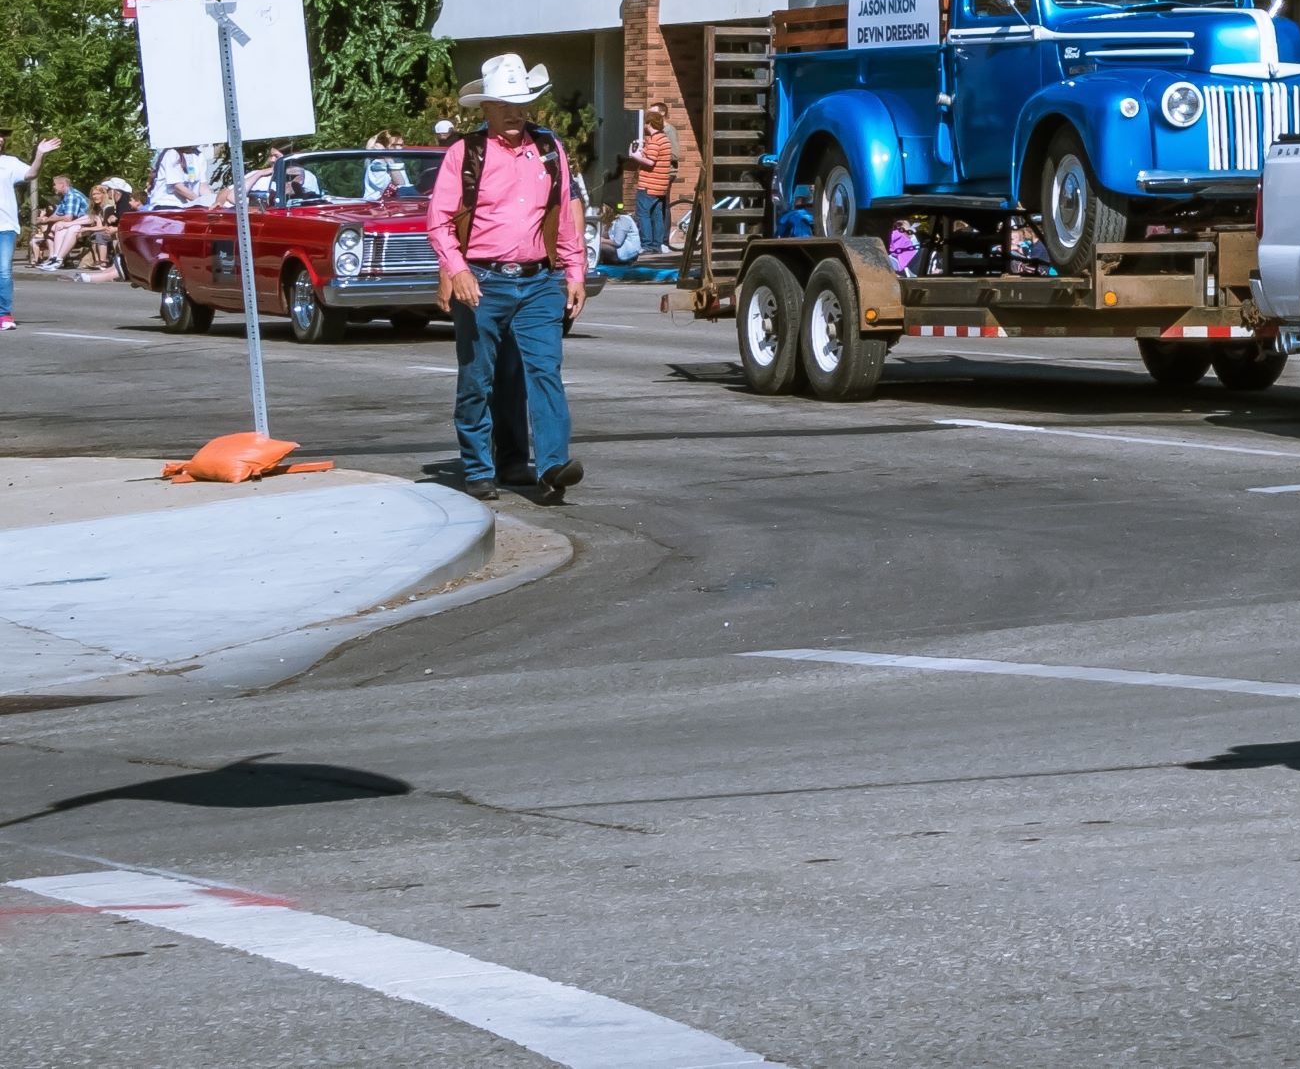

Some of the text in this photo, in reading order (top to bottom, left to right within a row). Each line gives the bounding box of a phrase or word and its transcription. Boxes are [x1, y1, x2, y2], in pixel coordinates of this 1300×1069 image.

[857, 0, 887, 17] JASON
[857, 22, 930, 44] DEVIN DREESHEN
